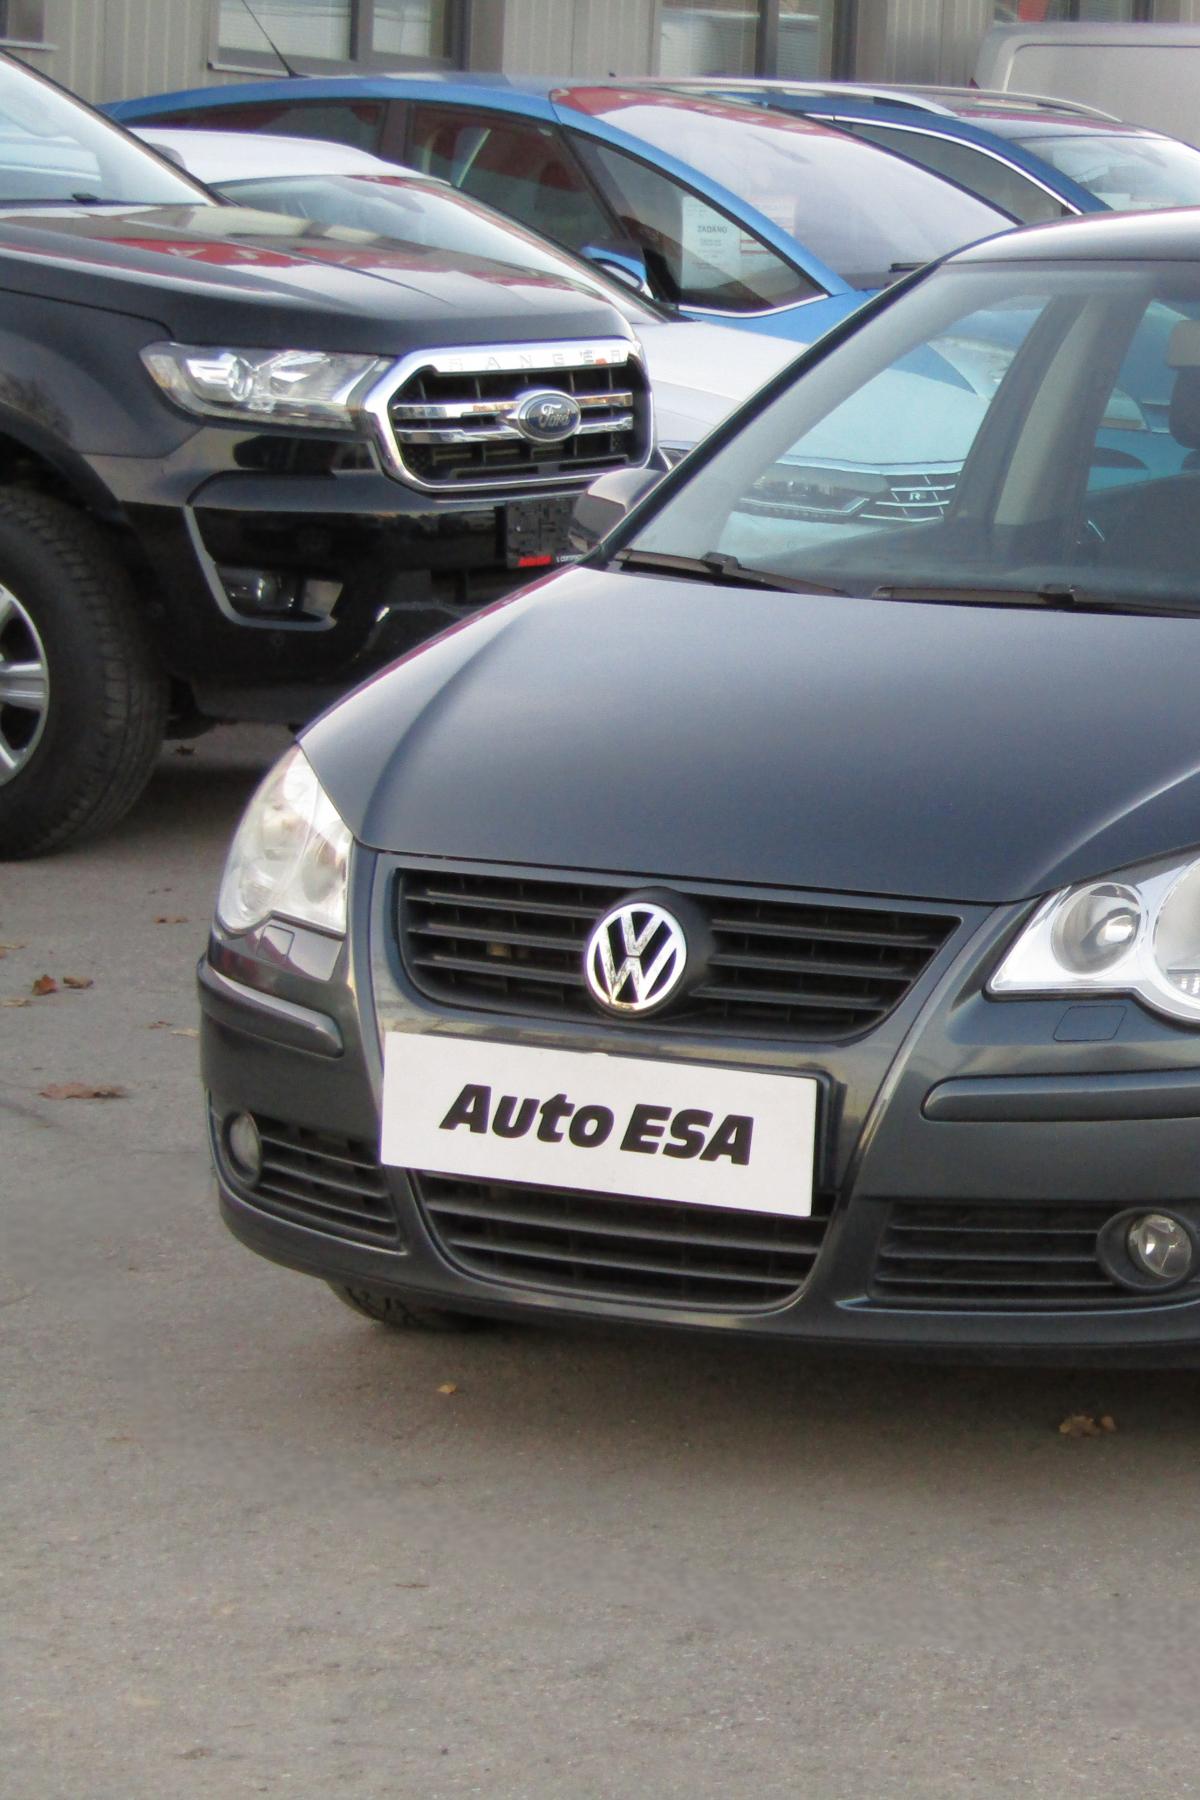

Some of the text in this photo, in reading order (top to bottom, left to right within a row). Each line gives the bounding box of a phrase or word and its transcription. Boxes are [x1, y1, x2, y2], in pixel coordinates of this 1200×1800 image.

[449, 350, 622, 371] RANGER
[538, 403, 571, 428] Ford
[440, 1085, 753, 1165] Auto ESA
